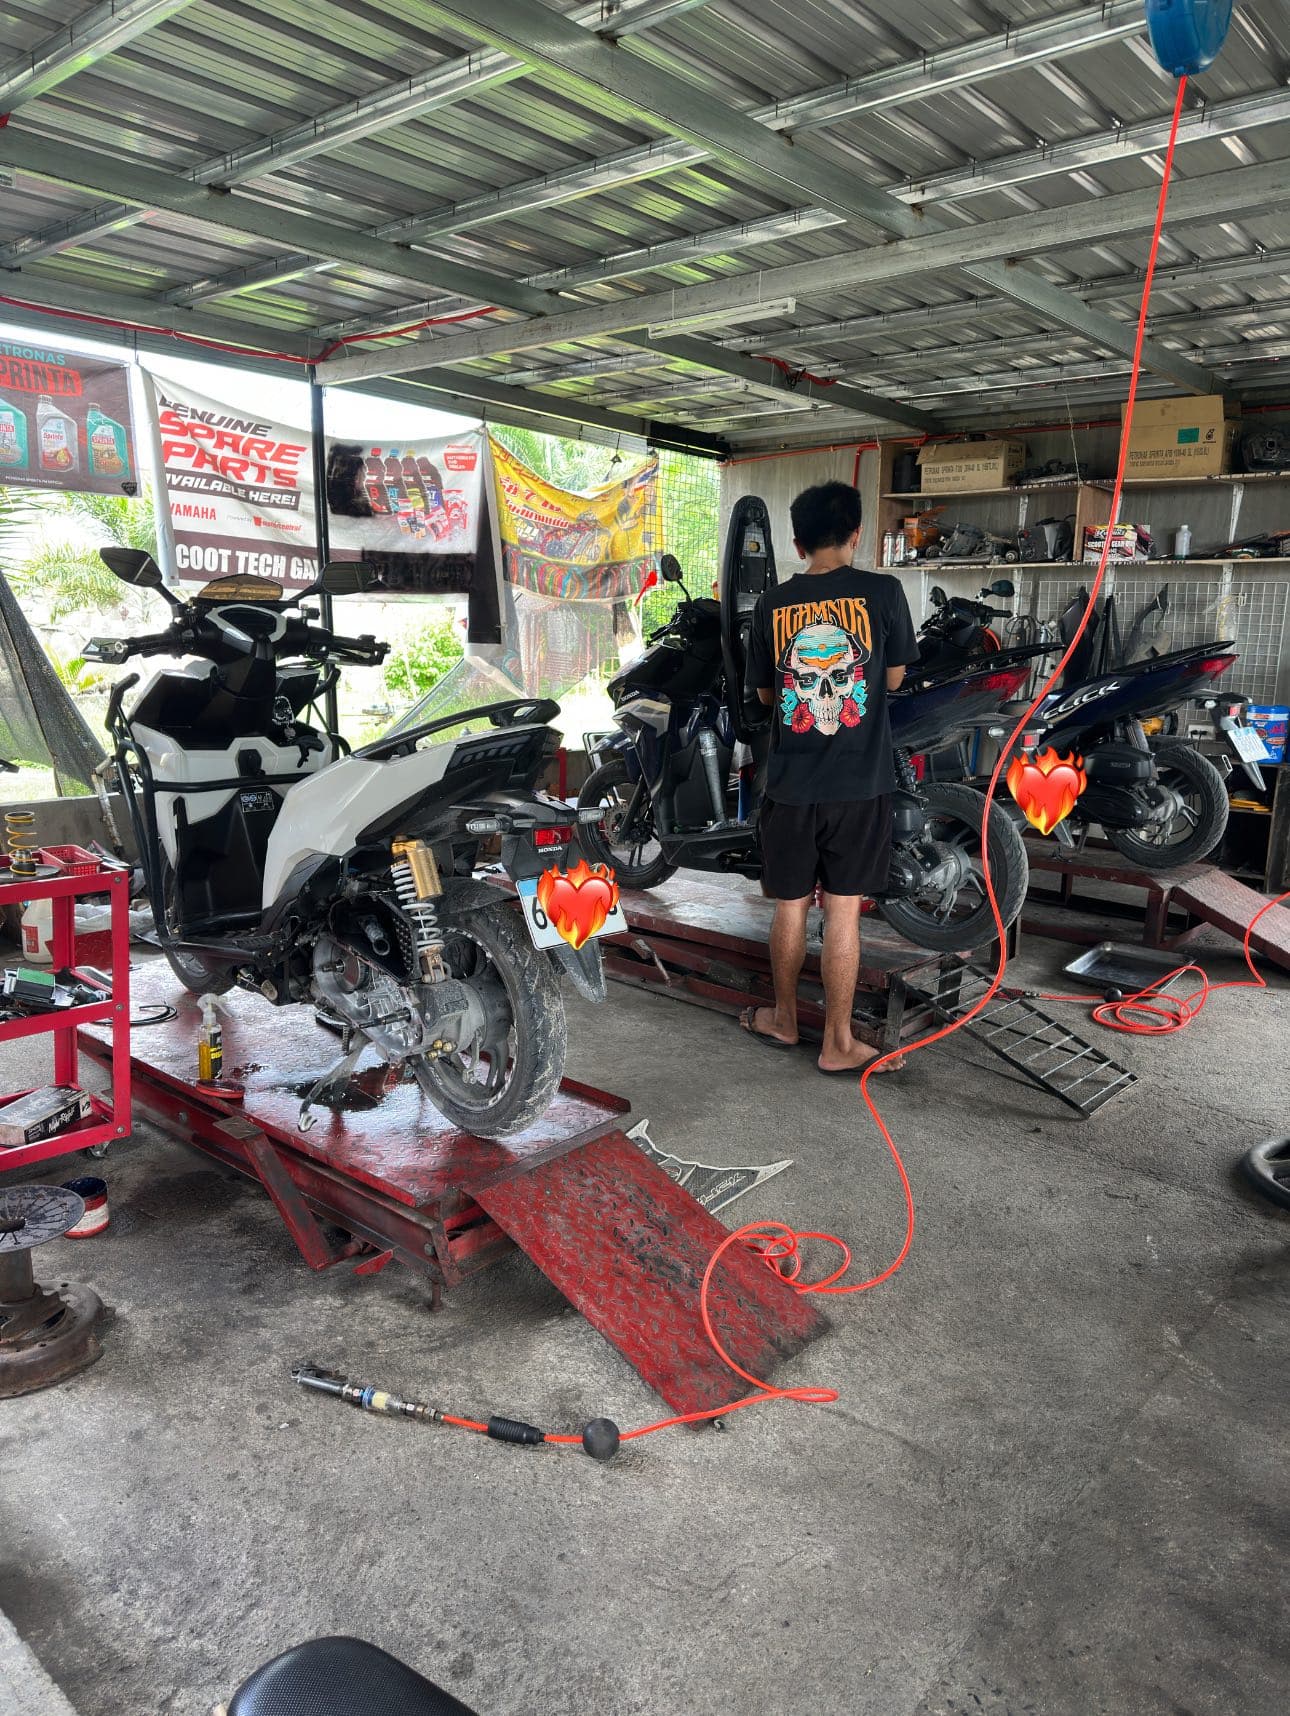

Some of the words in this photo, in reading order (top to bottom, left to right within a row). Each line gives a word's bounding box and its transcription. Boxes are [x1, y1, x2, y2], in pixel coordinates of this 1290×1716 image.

[0, 343, 66, 366] TRONAS
[160, 411, 308, 466] SPARE
[162, 440, 298, 488] PARTS
[248, 491, 296, 506] HERE!
[170, 503, 217, 520] YAMAHA
[175, 544, 231, 572] COOT
[236, 550, 287, 578] TECH
[538, 845, 563, 853] HONDA
